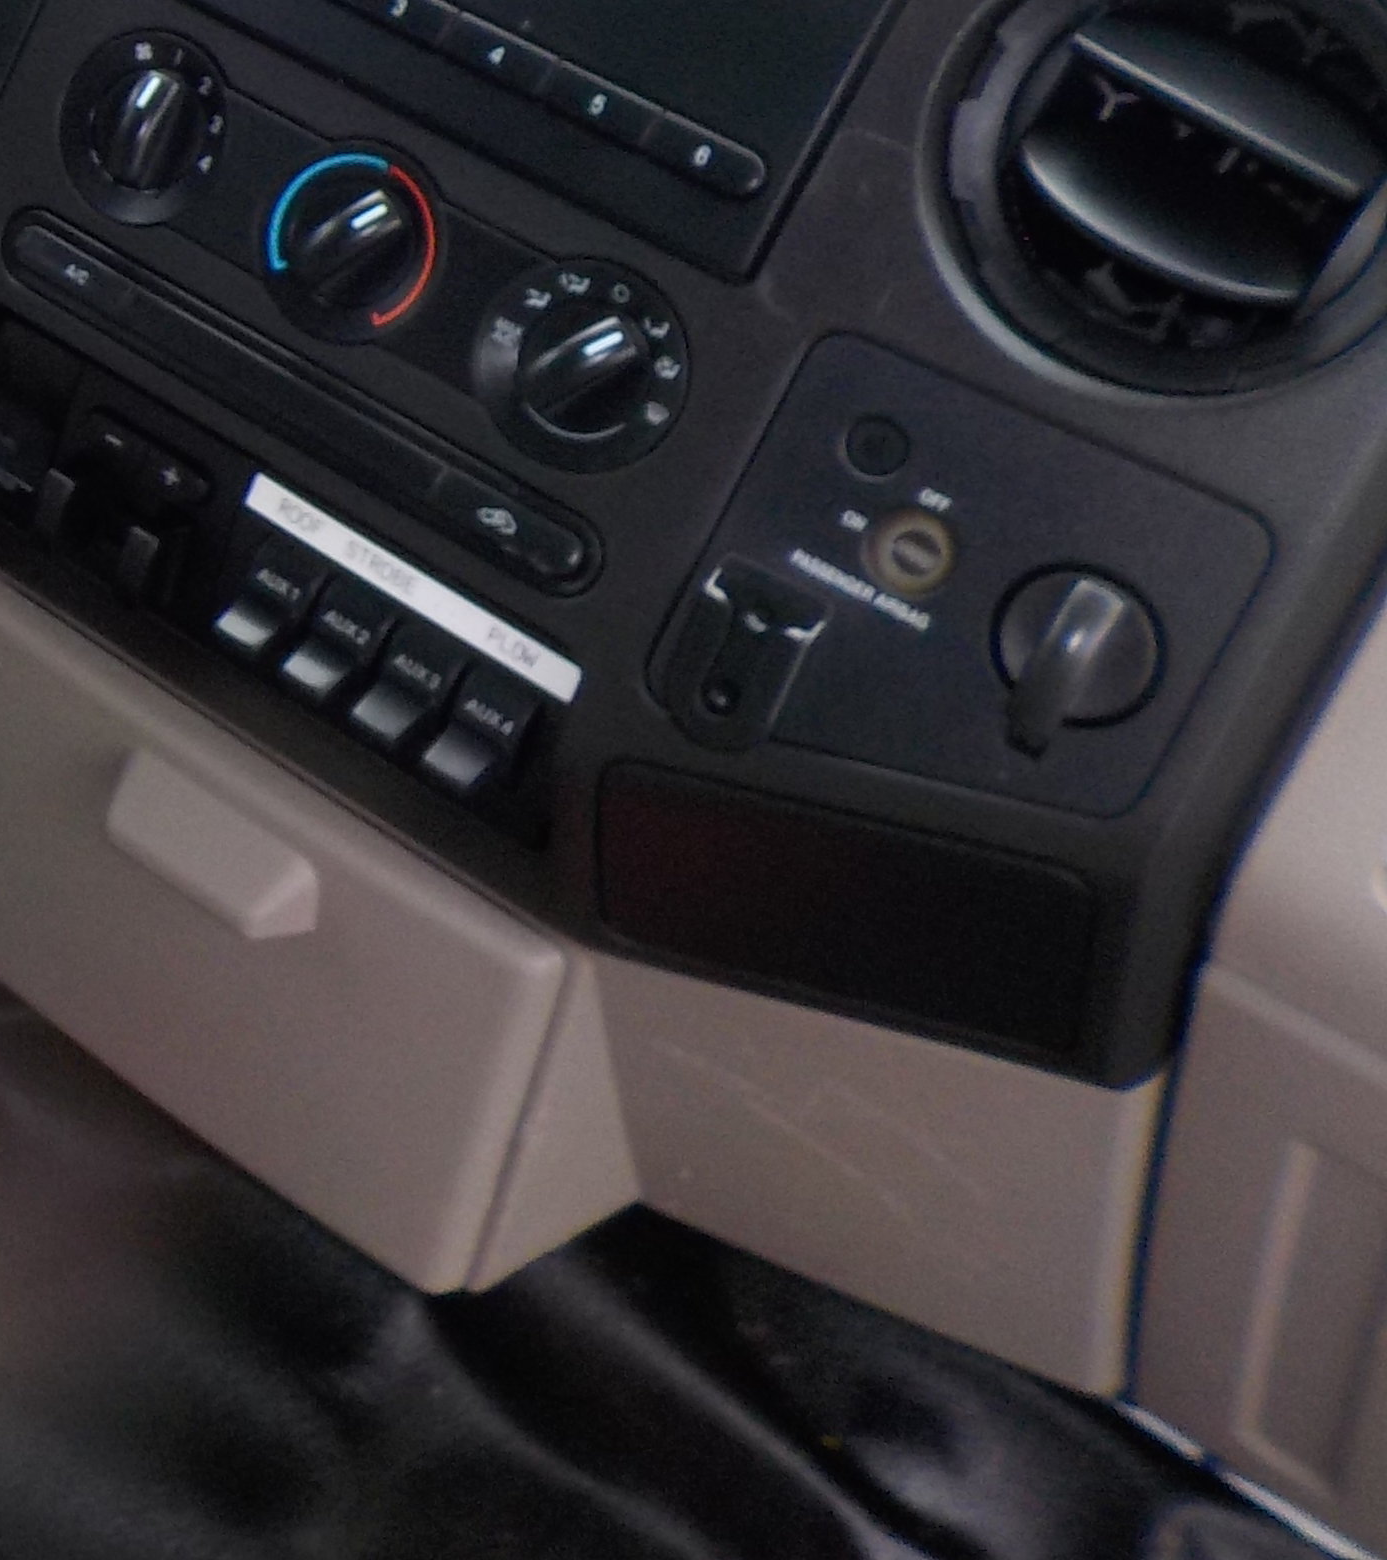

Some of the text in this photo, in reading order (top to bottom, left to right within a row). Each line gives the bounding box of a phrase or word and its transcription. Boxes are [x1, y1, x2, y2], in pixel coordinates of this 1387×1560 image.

[487, 45, 506, 66] 4
[198, 75, 213, 96] 2
[587, 92, 608, 118] 5
[208, 113, 225, 135] 3
[197, 155, 214, 175] 4
[693, 144, 713, 168] 6
[917, 486, 953, 512] OFF
[839, 509, 869, 532] ON
[279, 496, 542, 669] ROOF STROBE PLOW
